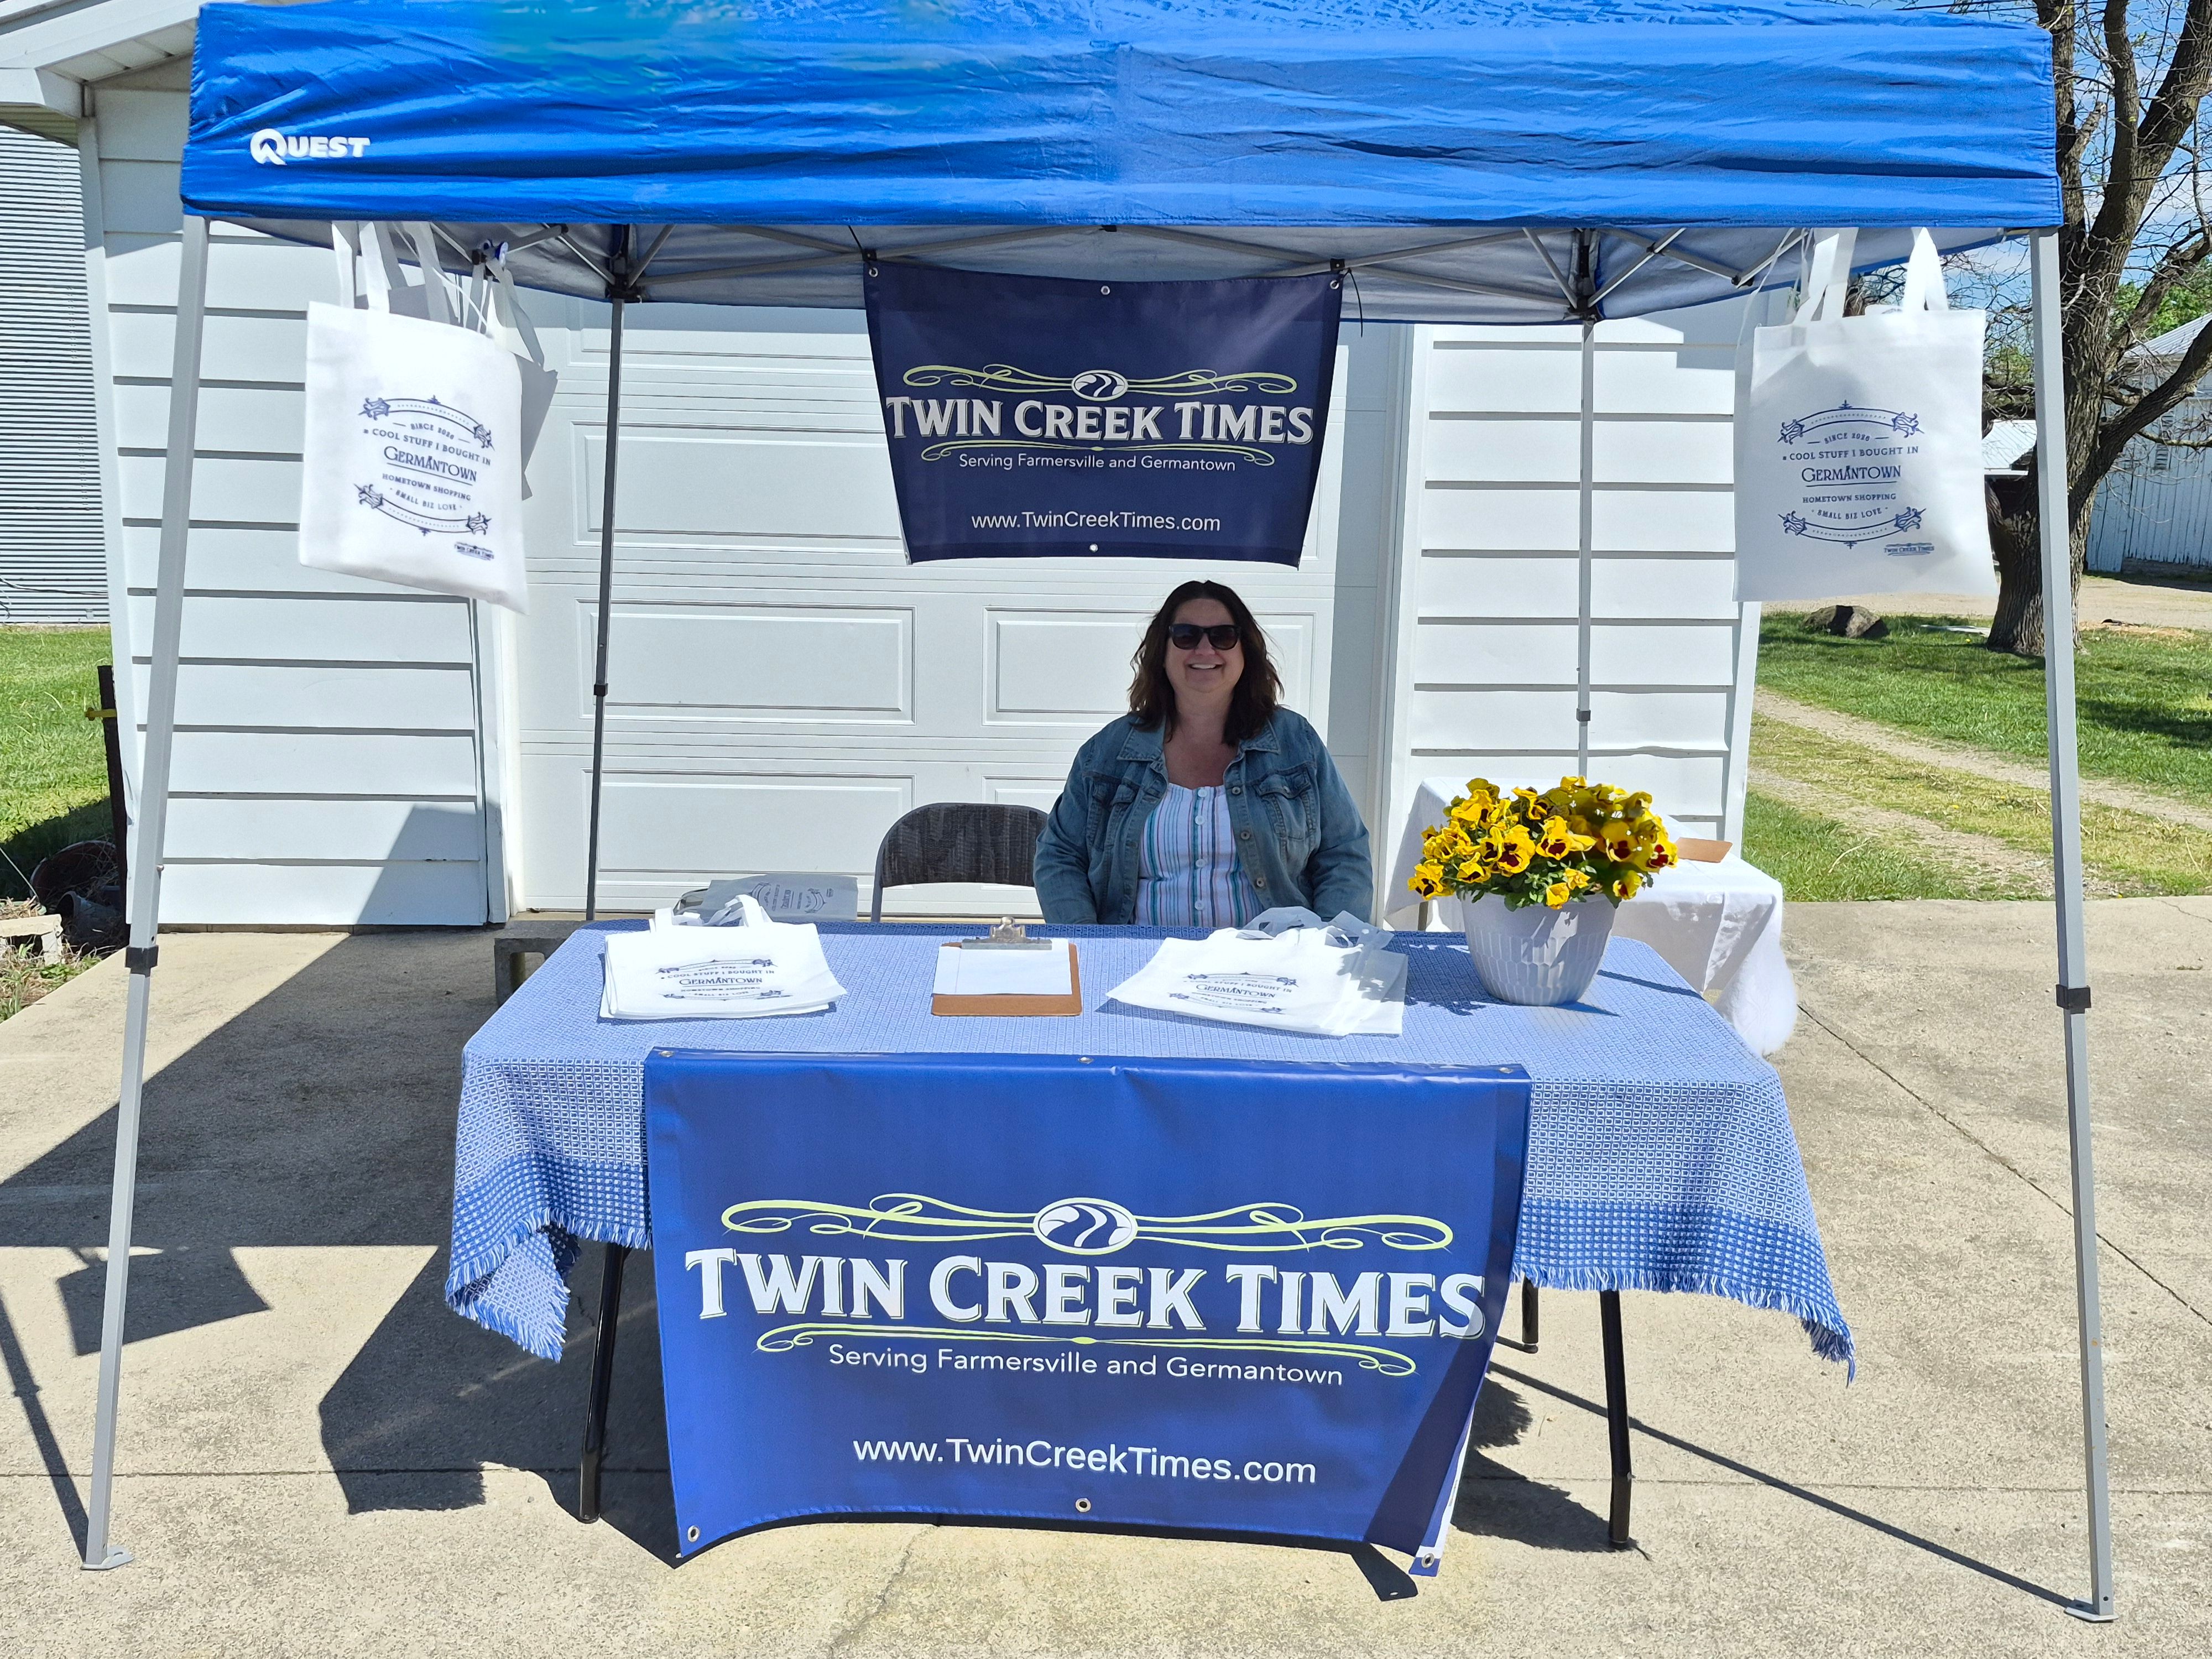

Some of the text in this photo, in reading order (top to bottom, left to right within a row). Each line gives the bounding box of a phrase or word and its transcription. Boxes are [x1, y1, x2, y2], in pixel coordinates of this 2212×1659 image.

[250, 128, 371, 165] QUEST
[885, 396, 1314, 445] TWIN CREEK TIMES
[372, 428, 400, 440] COOL
[403, 435, 433, 448] STUFF
[442, 445, 480, 462] BOUGHT
[482, 457, 491, 466] IN
[1790, 452, 1815, 461] COOL
[1819, 450, 1849, 459] STUFF
[1859, 447, 1903, 457] BOUGHT
[384, 446, 477, 482] GERMANTOWN
[958, 454, 1235, 472] Serving Farmersville and Germantown
[1801, 465, 1901, 482] GERMANTOWN
[382, 473, 471, 500] HOMETOWN SHOPPING
[395, 489, 419, 504] SMALL
[422, 500, 434, 509] BIZ
[971, 511, 1221, 531] www.TwinCreekTimes.com
[1817, 509, 1841, 519] SMALL
[1861, 508, 1882, 518] LOVE
[1196, 984, 1276, 998] GERMANTOWN
[685, 1248, 1486, 1339] TWIN CREEK TIMES
[829, 1344, 1343, 1385] Serving Farmersville and Germantown
[853, 1438, 1316, 1484] www.TwinCreekTimes.com
